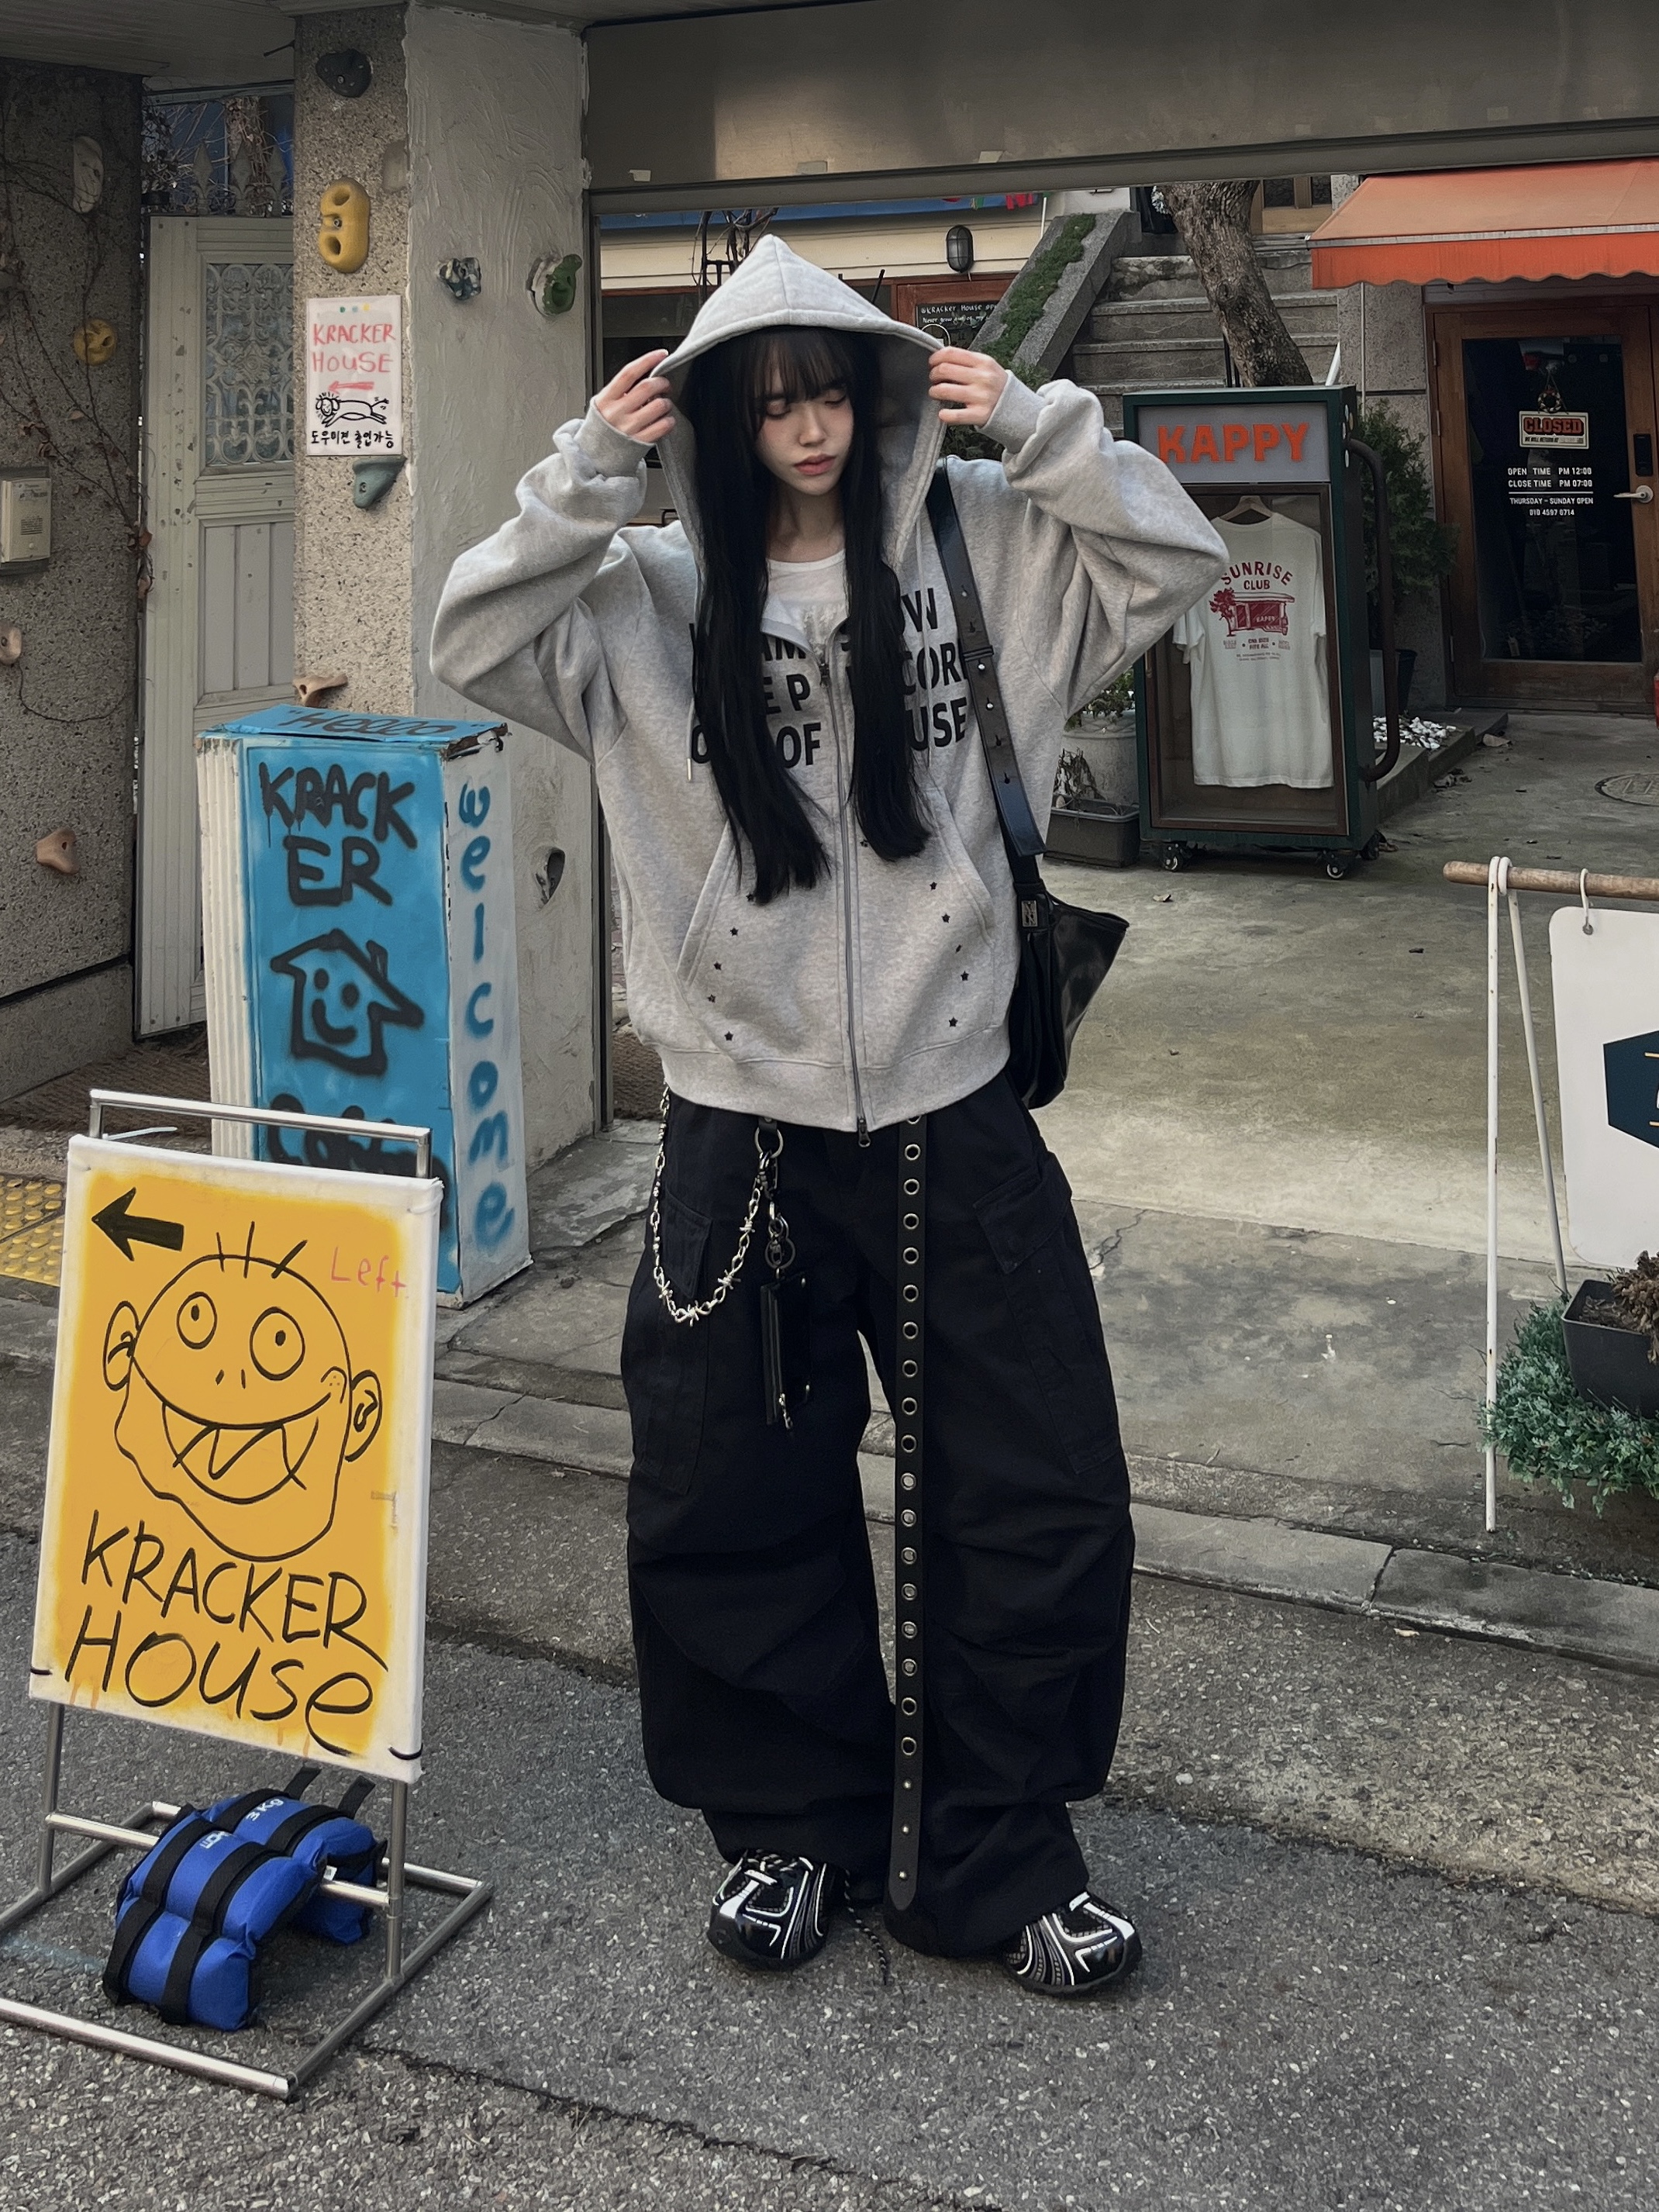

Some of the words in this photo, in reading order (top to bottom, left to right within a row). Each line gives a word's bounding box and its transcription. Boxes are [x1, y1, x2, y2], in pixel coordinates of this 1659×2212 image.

[313, 323, 396, 346] KRACKER
[311, 430, 350, 445] 도우미견
[1523, 417, 1585, 436] CLOSED
[1157, 423, 1309, 463] KAPPY
[1221, 561, 1293, 585] SUNRISE
[1243, 580, 1271, 590] CLUB
[258, 761, 419, 850] KRACK
[284, 833, 393, 908] ER
[331, 1245, 408, 1297] Left
[81, 1509, 389, 1672] KRACKER
